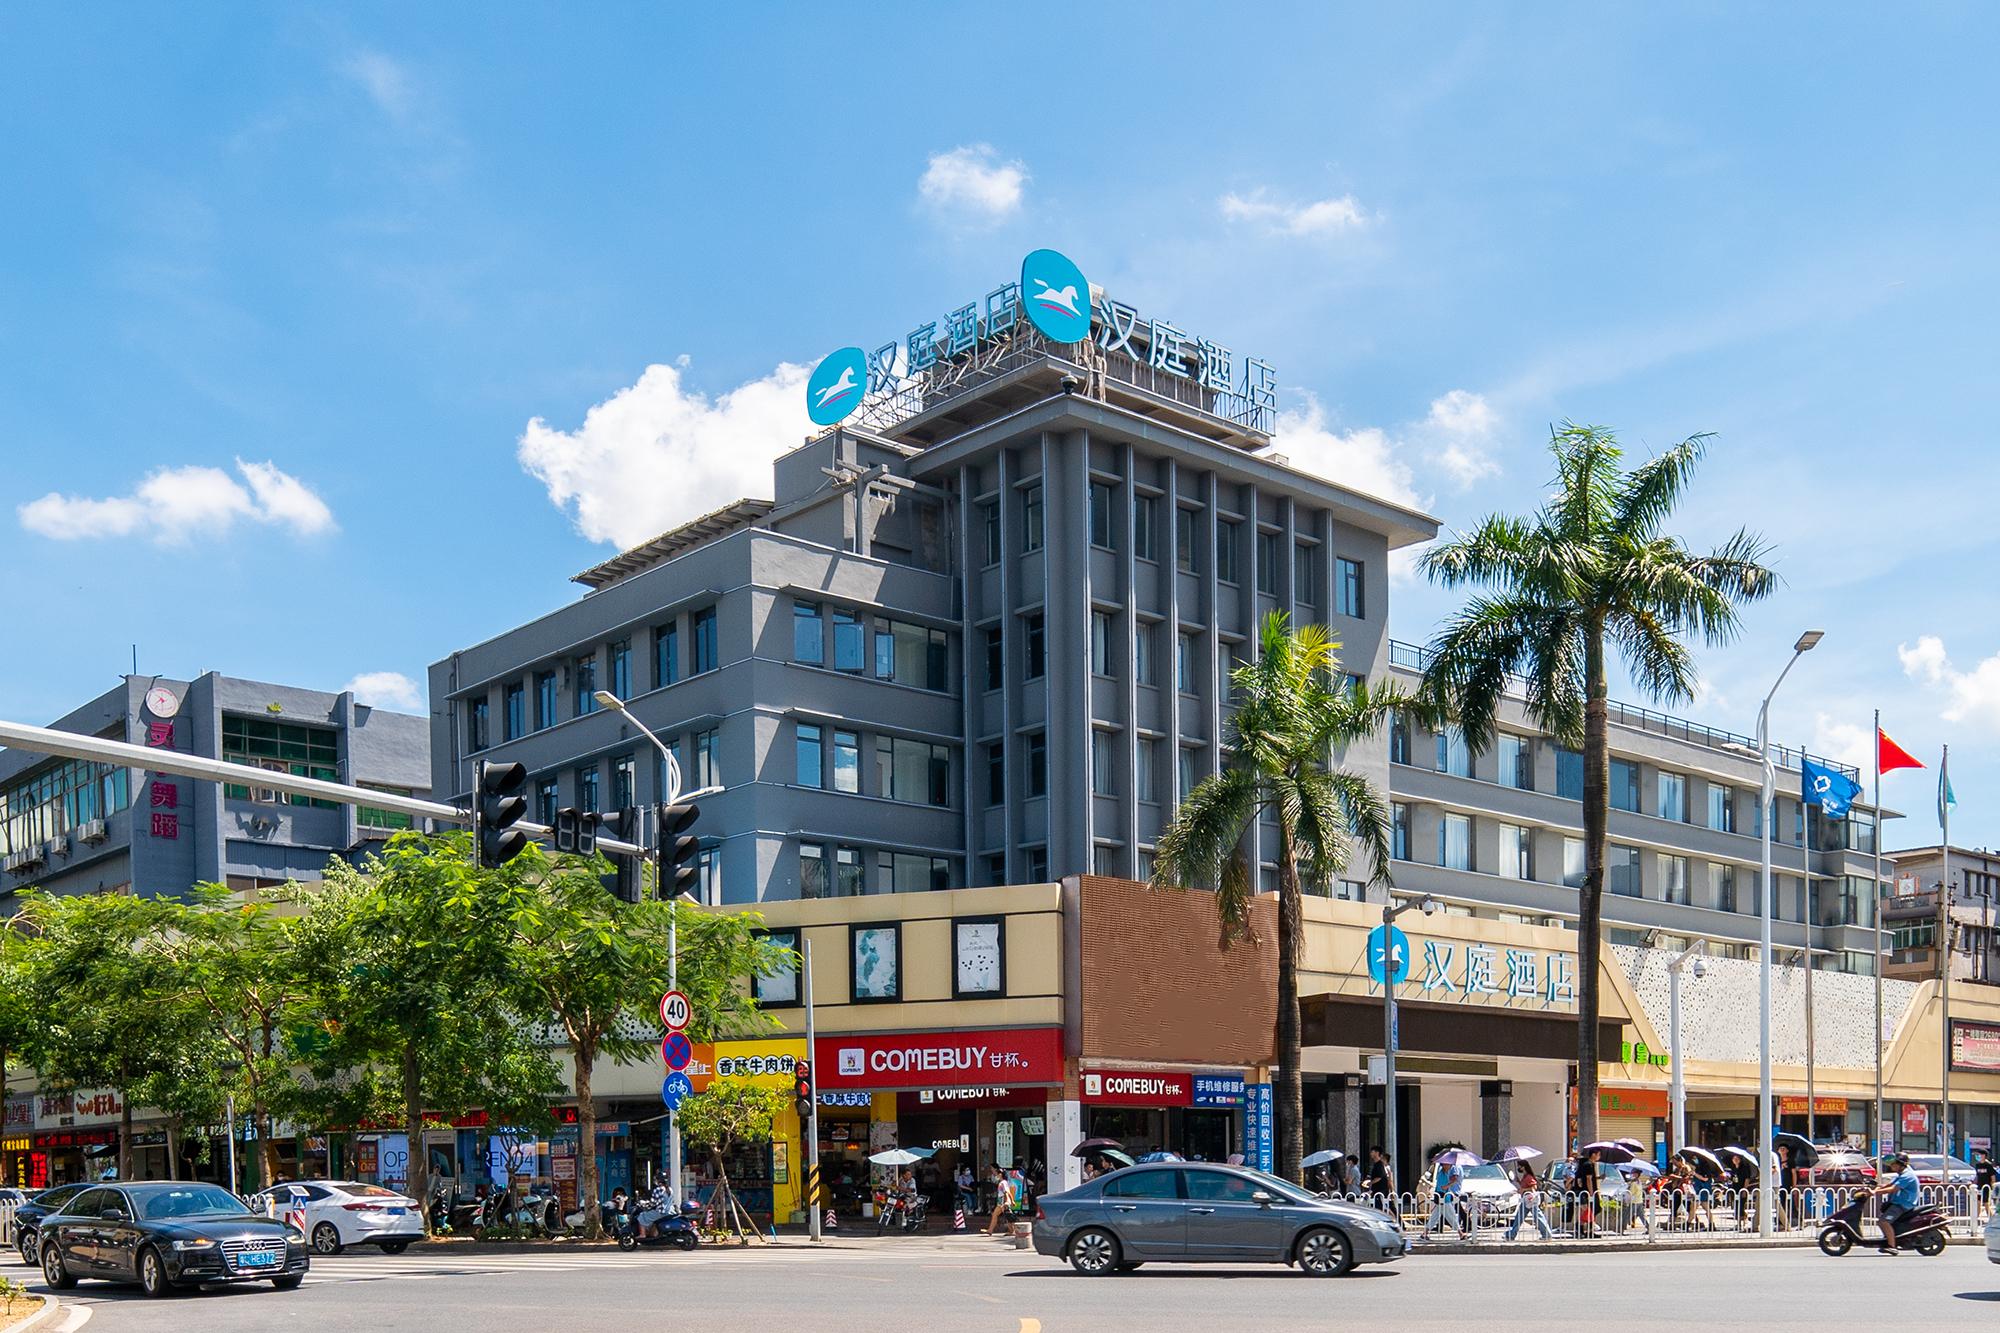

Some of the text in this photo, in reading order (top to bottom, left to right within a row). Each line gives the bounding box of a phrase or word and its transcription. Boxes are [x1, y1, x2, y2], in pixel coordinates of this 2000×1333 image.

[867, 282, 1017, 393] 汉庭酒店
[1099, 298, 1280, 413] 汉庭酒店
[149, 720, 179, 840] 灵舞蹈
[1424, 940, 1575, 1003] 汉庭酒店
[667, 1000, 685, 1019] 40
[718, 1055, 797, 1077] 香酥牛肉饼
[870, 1047, 987, 1072] COMEBUY
[1105, 1077, 1166, 1095] COMEBUY
[1246, 1087, 1257, 1168] 专业快速维修
[1261, 1087, 1270, 1174] 高价回收二手
